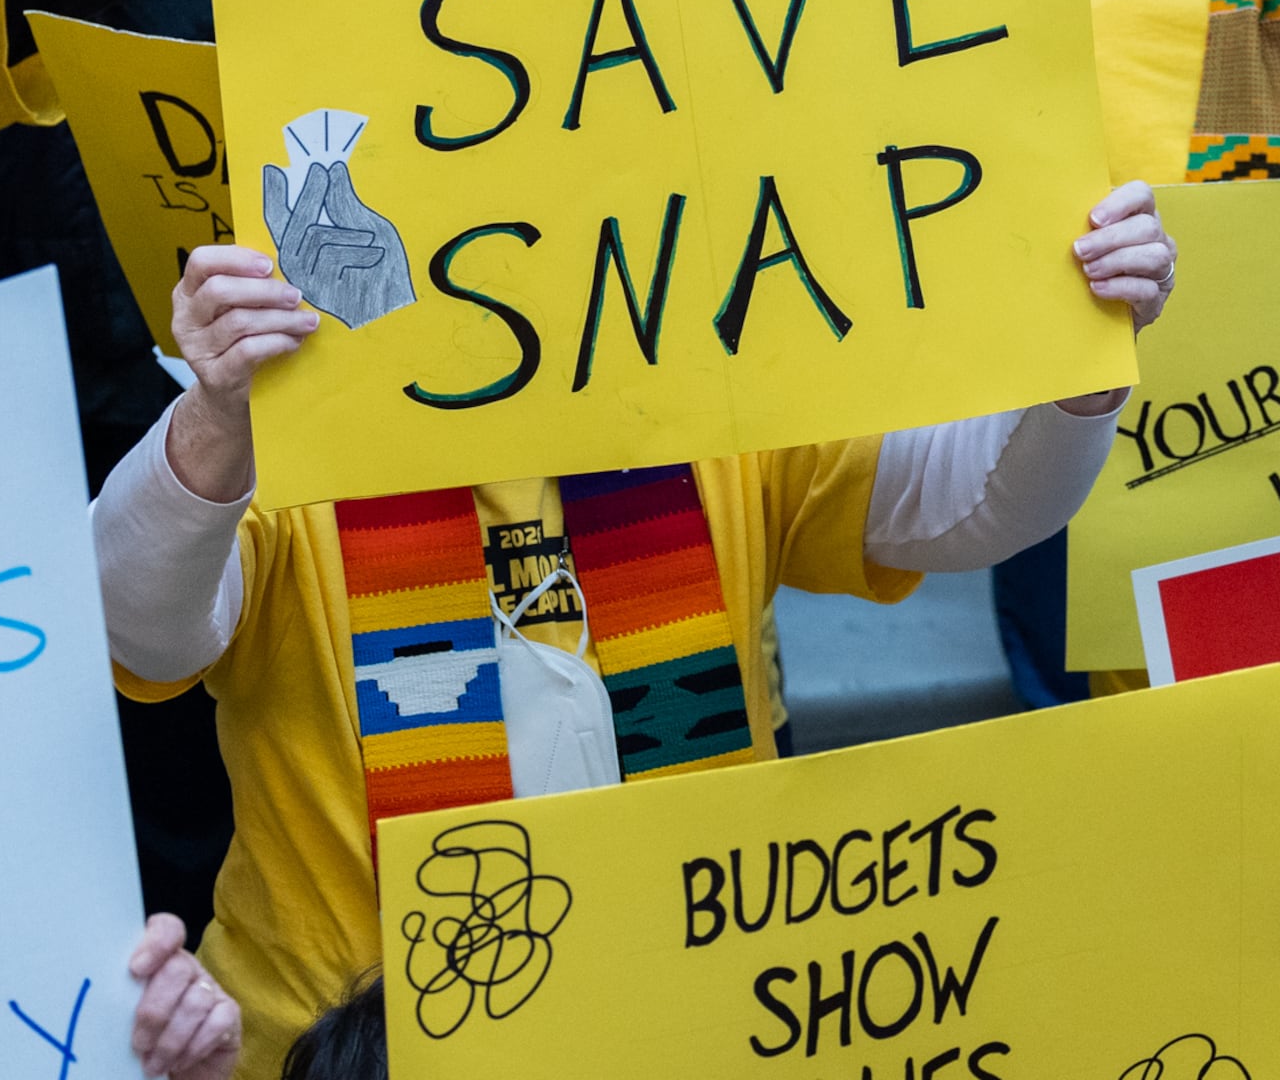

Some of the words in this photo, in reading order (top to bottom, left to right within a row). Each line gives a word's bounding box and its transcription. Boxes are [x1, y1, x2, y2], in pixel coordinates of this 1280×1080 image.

[402, 144, 984, 411] SNAP
[681, 805, 998, 949] BUDGETS
[749, 916, 1000, 1060] SHOW
